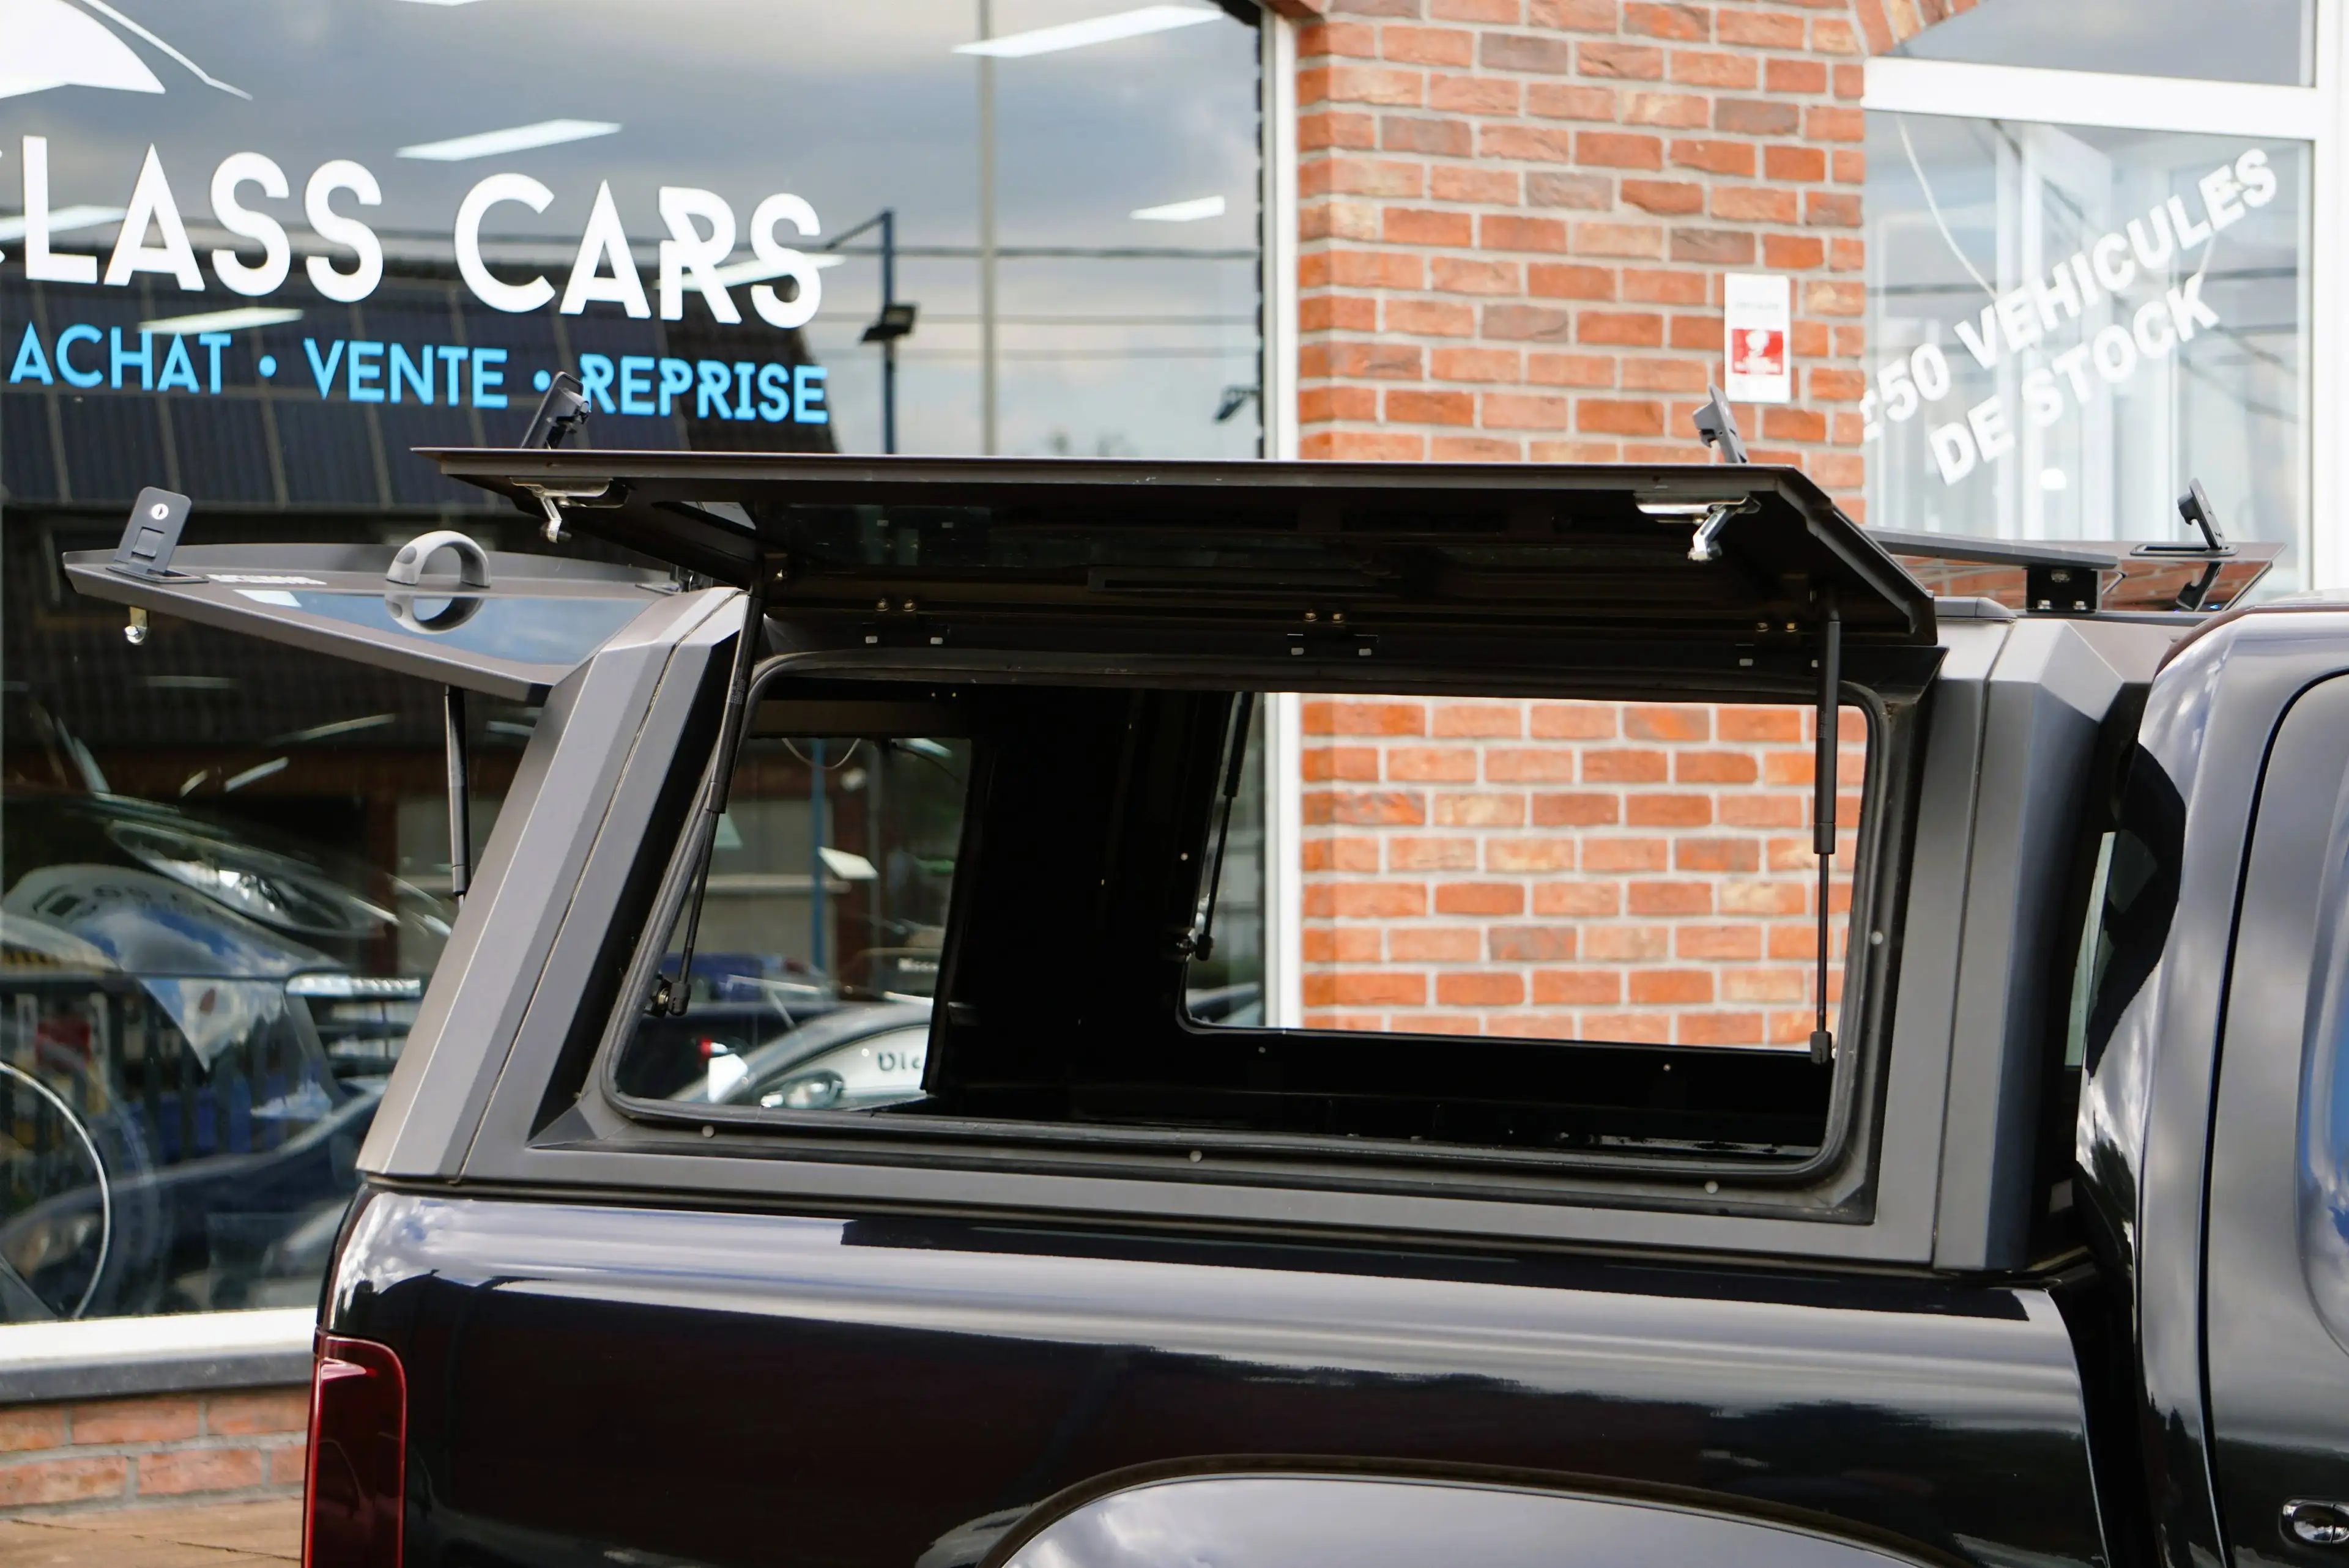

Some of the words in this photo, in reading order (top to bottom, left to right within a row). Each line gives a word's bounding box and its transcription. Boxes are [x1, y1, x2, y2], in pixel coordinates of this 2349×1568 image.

[0, 136, 383, 302] LASS
[455, 173, 822, 328] CARS
[1954, 148, 2277, 368] VEHICULES
[9, 322, 231, 394] ACHAT
[303, 339, 507, 408] VENTE
[579, 353, 828, 424] REPRISE
[1929, 396, 2016, 486] DE
[2022, 273, 2219, 428] STOCK
